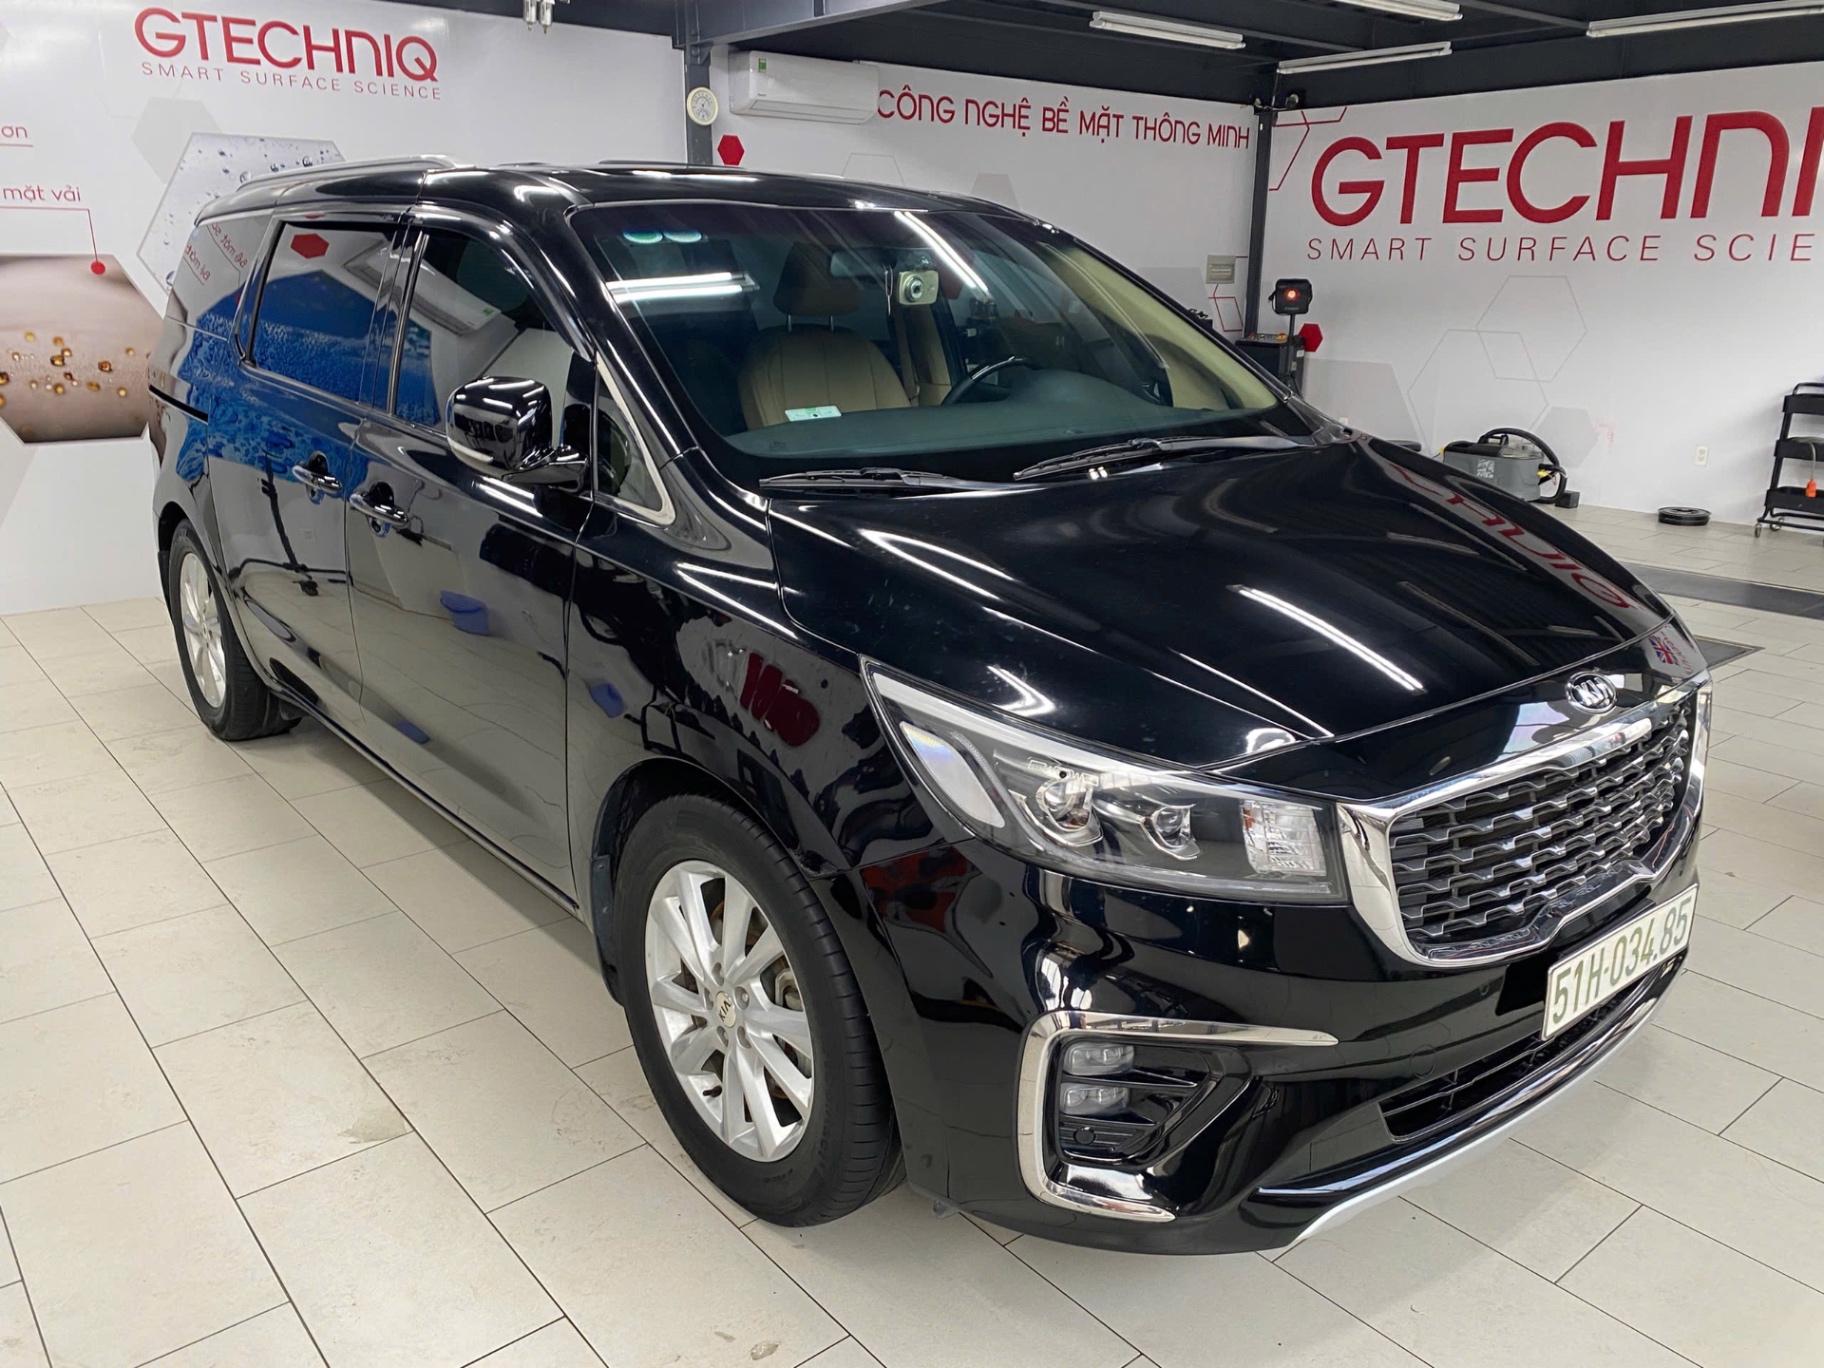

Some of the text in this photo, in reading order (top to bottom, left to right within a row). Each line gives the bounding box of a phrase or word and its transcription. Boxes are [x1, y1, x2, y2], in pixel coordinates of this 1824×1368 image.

[134, 7, 439, 82] GTECHNIQ
[141, 61, 442, 100] SMART SURFACE SCIENCE
[877, 84, 1250, 149] CÔNG NGHỆ BỀ MẶT THÔNG MINH
[3, 184, 82, 203] mặt vải
[1306, 233, 1816, 262] SMART SURFACE SCIE
[1551, 894, 1693, 1025] 51H-034.85
[718, 999, 732, 1023] KIA
